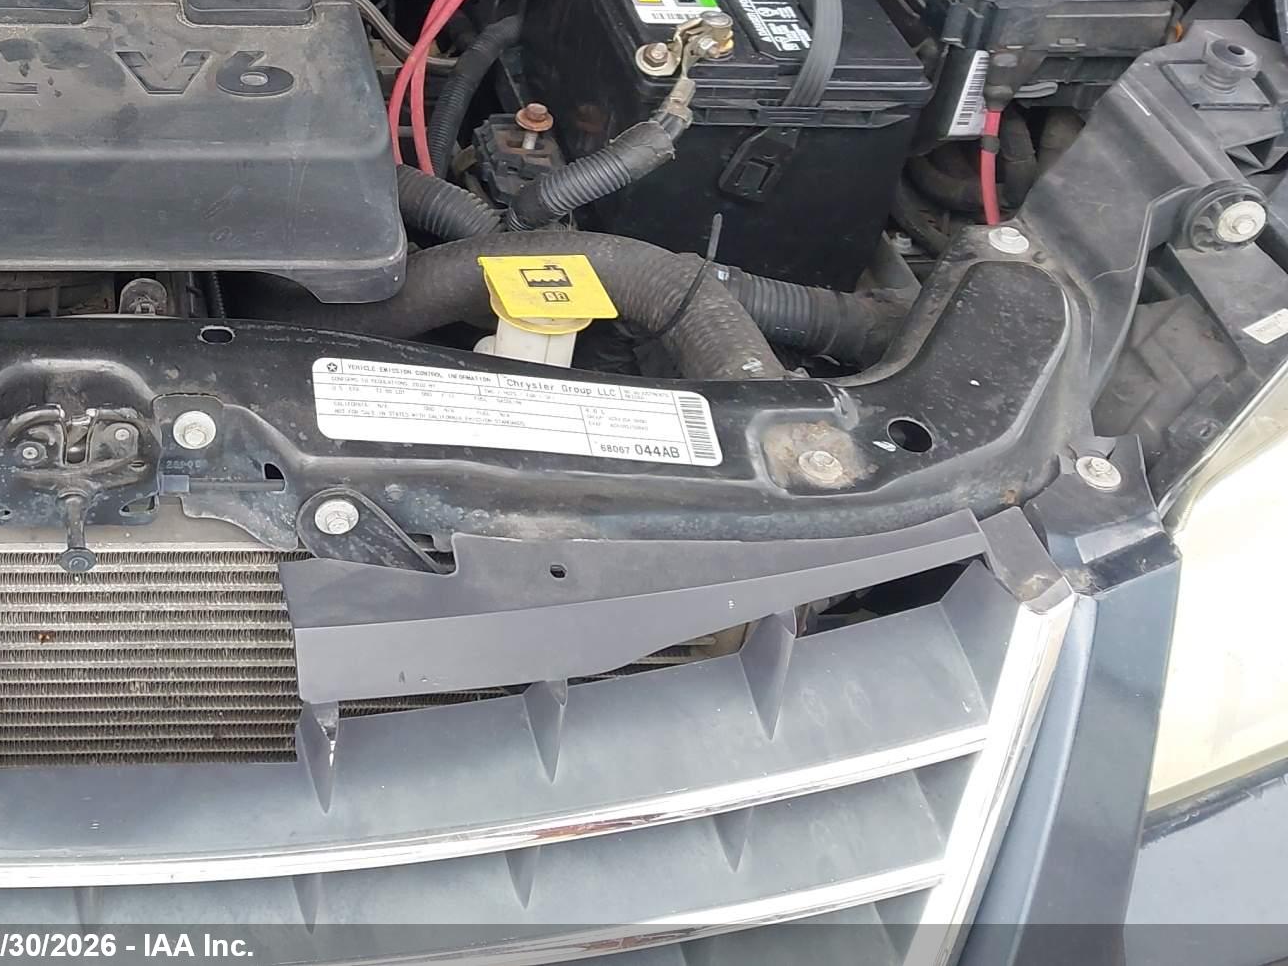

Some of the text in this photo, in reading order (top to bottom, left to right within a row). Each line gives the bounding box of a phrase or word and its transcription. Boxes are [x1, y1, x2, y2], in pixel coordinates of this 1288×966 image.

[114, 50, 295, 98] V6
[347, 364, 491, 382] VEHICLE EMISSION CONTROL INFORMATION
[506, 378, 616, 396] Chrysler Group LLC
[600, 444, 680, 458] 68067 044AB
